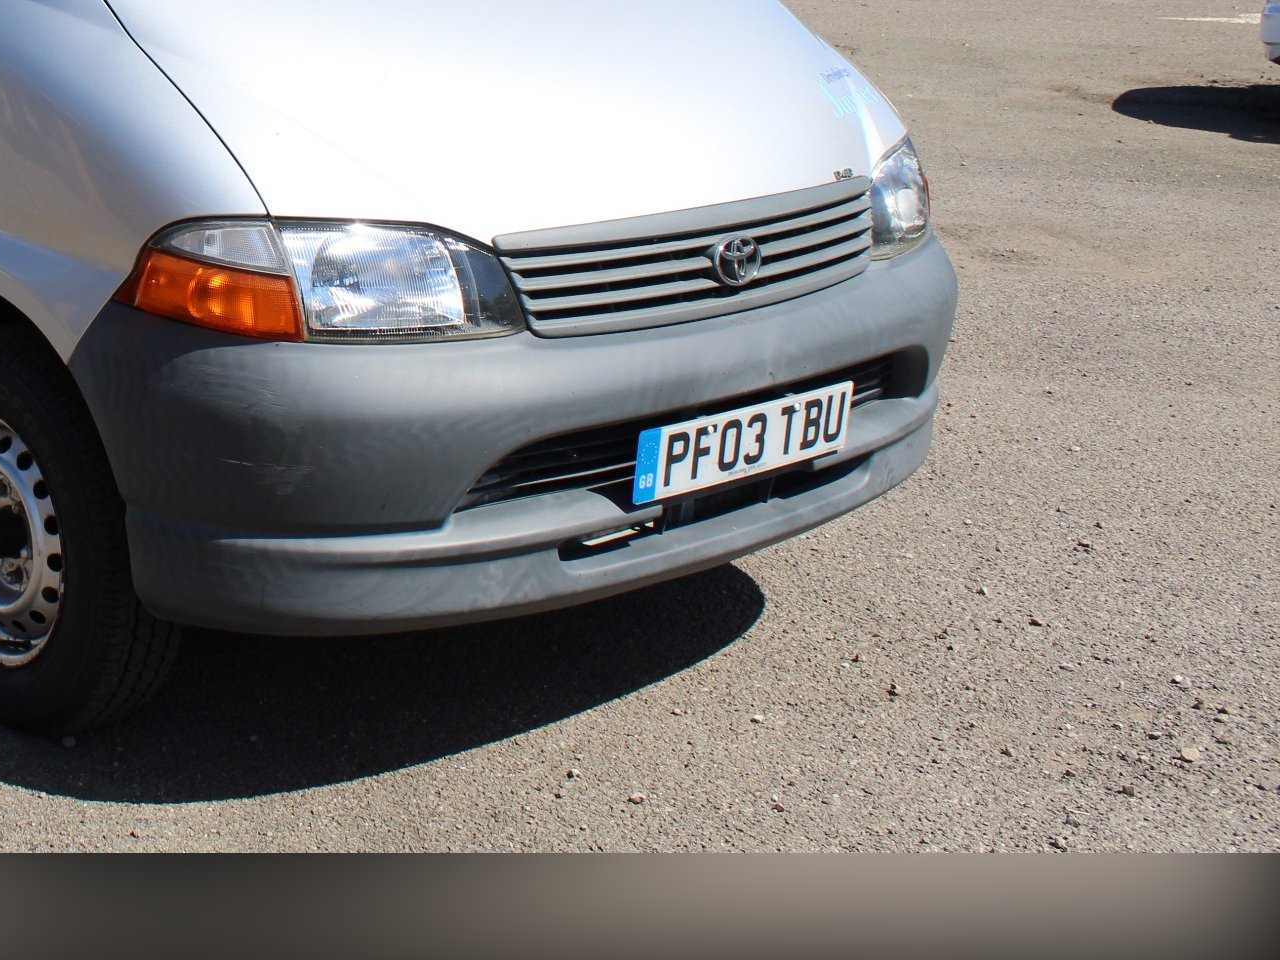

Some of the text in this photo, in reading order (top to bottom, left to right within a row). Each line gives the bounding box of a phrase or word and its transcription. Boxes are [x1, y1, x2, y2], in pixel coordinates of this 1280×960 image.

[663, 391, 847, 488] PF03 TBU
[639, 472, 654, 489] GB
